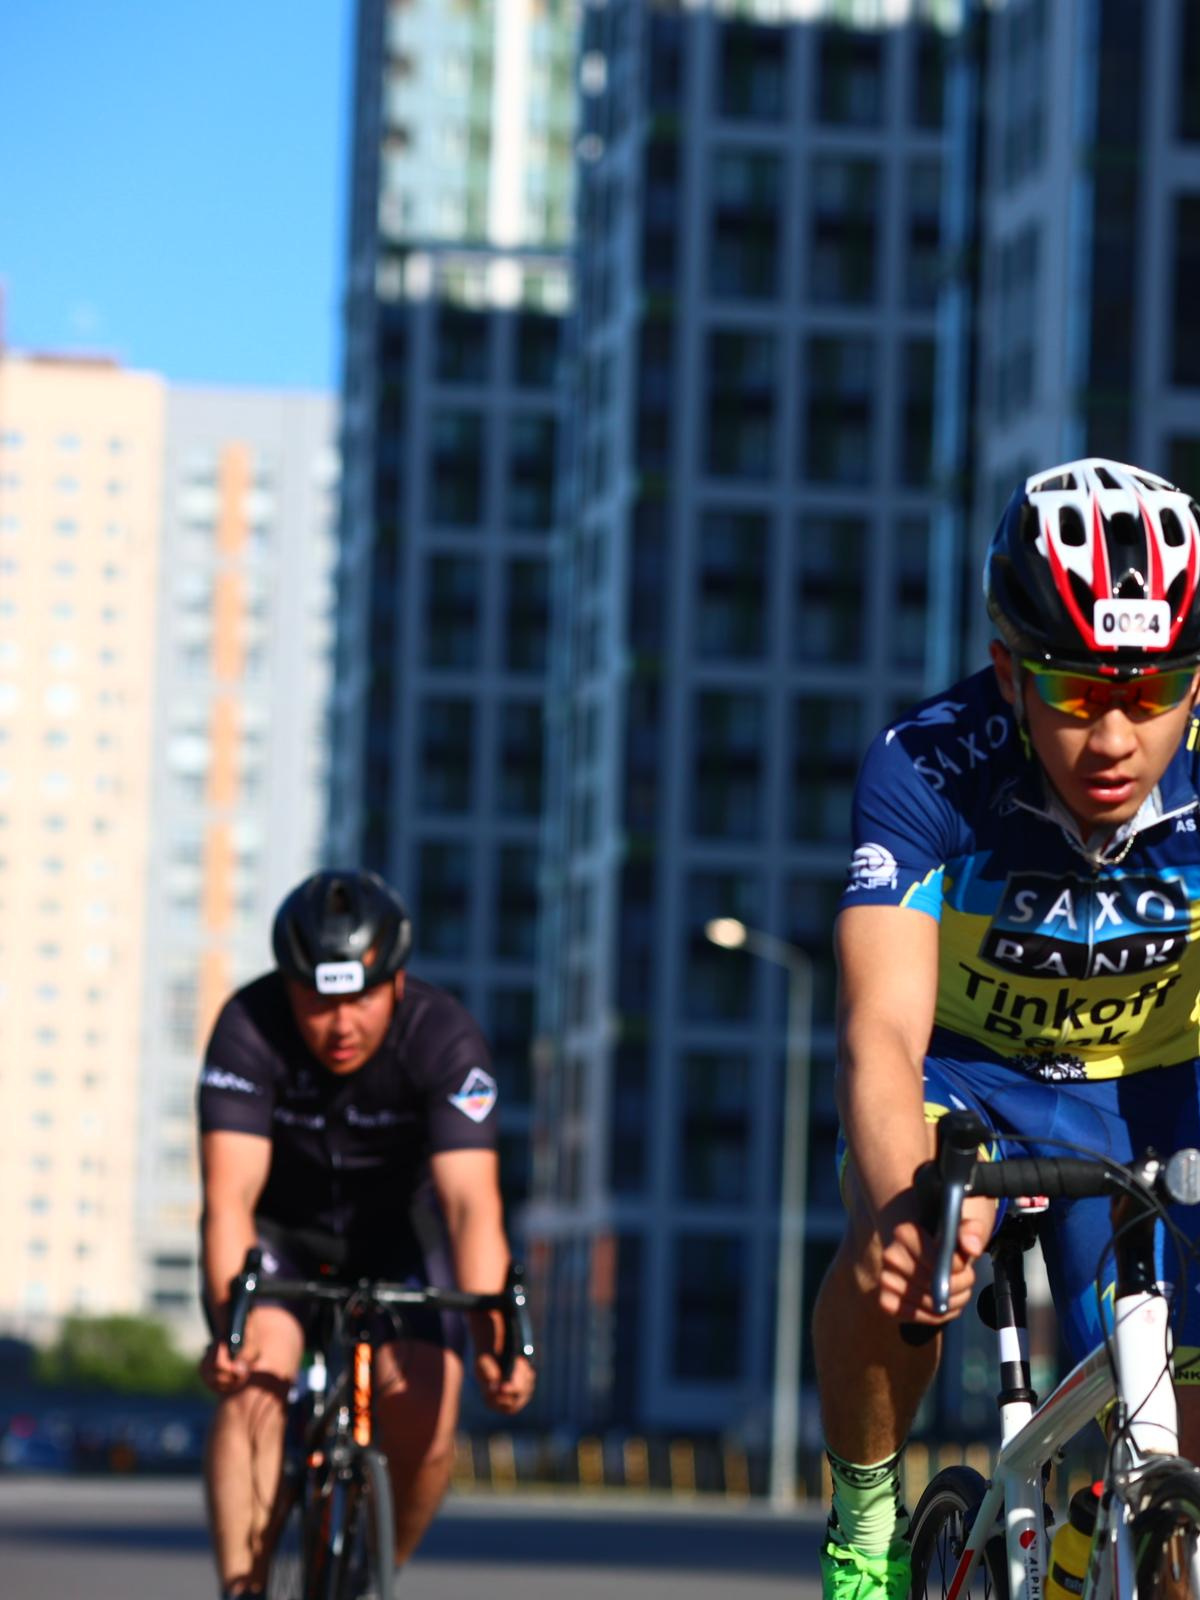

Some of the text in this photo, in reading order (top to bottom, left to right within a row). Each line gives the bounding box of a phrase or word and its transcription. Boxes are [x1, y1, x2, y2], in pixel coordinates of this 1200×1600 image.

[1102, 612, 1160, 634] 0024
[912, 714, 1009, 791] SAXO
[1007, 888, 1176, 931] SAXO
[994, 938, 1176, 977] BANK
[958, 961, 1183, 1031] Tinkoff
[1028, 1556, 1041, 1600] ALPH
